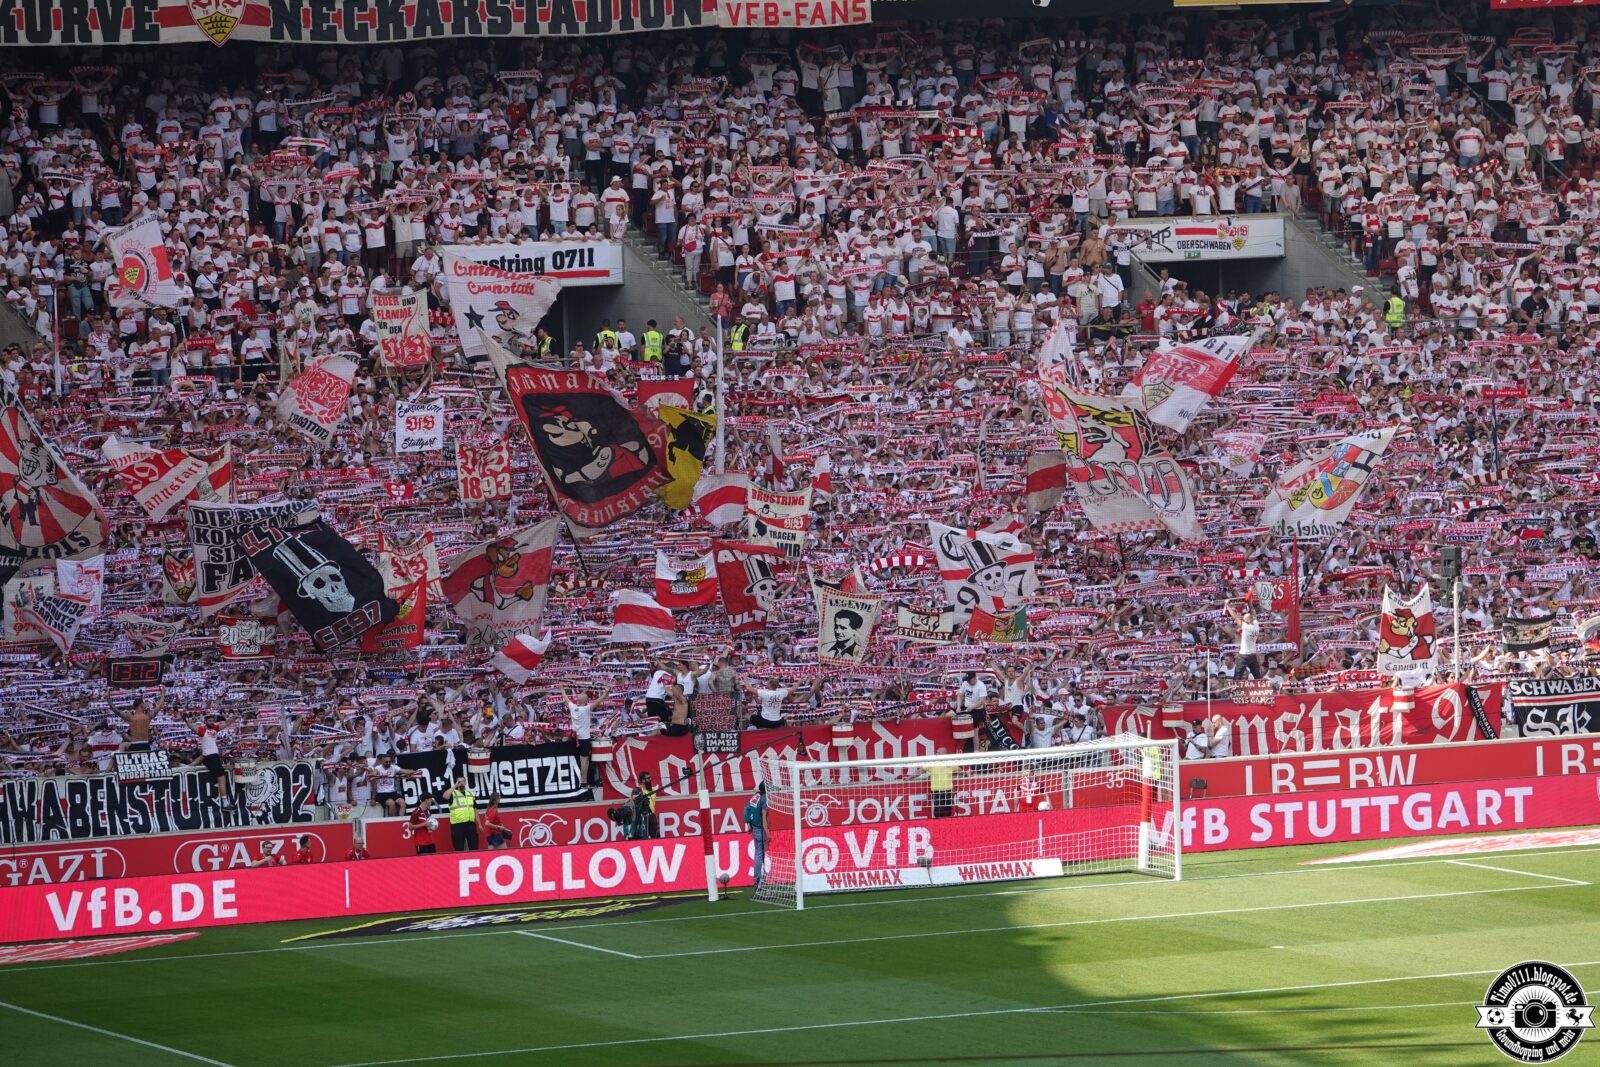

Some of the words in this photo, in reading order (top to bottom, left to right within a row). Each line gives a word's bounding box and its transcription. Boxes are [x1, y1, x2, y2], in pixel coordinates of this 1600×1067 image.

[270, 0, 702, 42] NECKARSTADION
[1177, 239, 1231, 251] OBERSCHWABEN
[476, 253, 545, 276] ustring
[552, 248, 594, 270] 0711
[374, 295, 399, 306] FEUER
[402, 295, 416, 305] UND
[376, 307, 412, 319] FLAMME
[389, 323, 402, 334] DEN
[401, 437, 436, 450] Stuttgart
[147, 460, 204, 511] annstatt
[460, 475, 511, 500] 1893
[752, 488, 805, 506] BRUSTRING
[190, 507, 233, 527] DIE
[769, 530, 797, 541] TRAGEN
[777, 542, 801, 557] WIR
[829, 598, 874, 613] LEGENDE
[220, 624, 239, 644] 20
[257, 624, 275, 645] 02
[313, 600, 383, 651] CC97
[899, 630, 950, 642] STUTTGART
[112, 662, 157, 681] 13:12
[1431, 687, 1493, 744] 97
[116, 751, 168, 765] ULTRAS
[118, 761, 170, 773] BEDEUTET
[119, 769, 172, 781] WIDERSTAND
[1250, 786, 1533, 843] STUTTGART
[458, 842, 687, 898] FOLLOW
[826, 868, 904, 889] WINAMAX
[958, 861, 1036, 882] WINAMAX
[46, 880, 238, 932] VfB.DE
